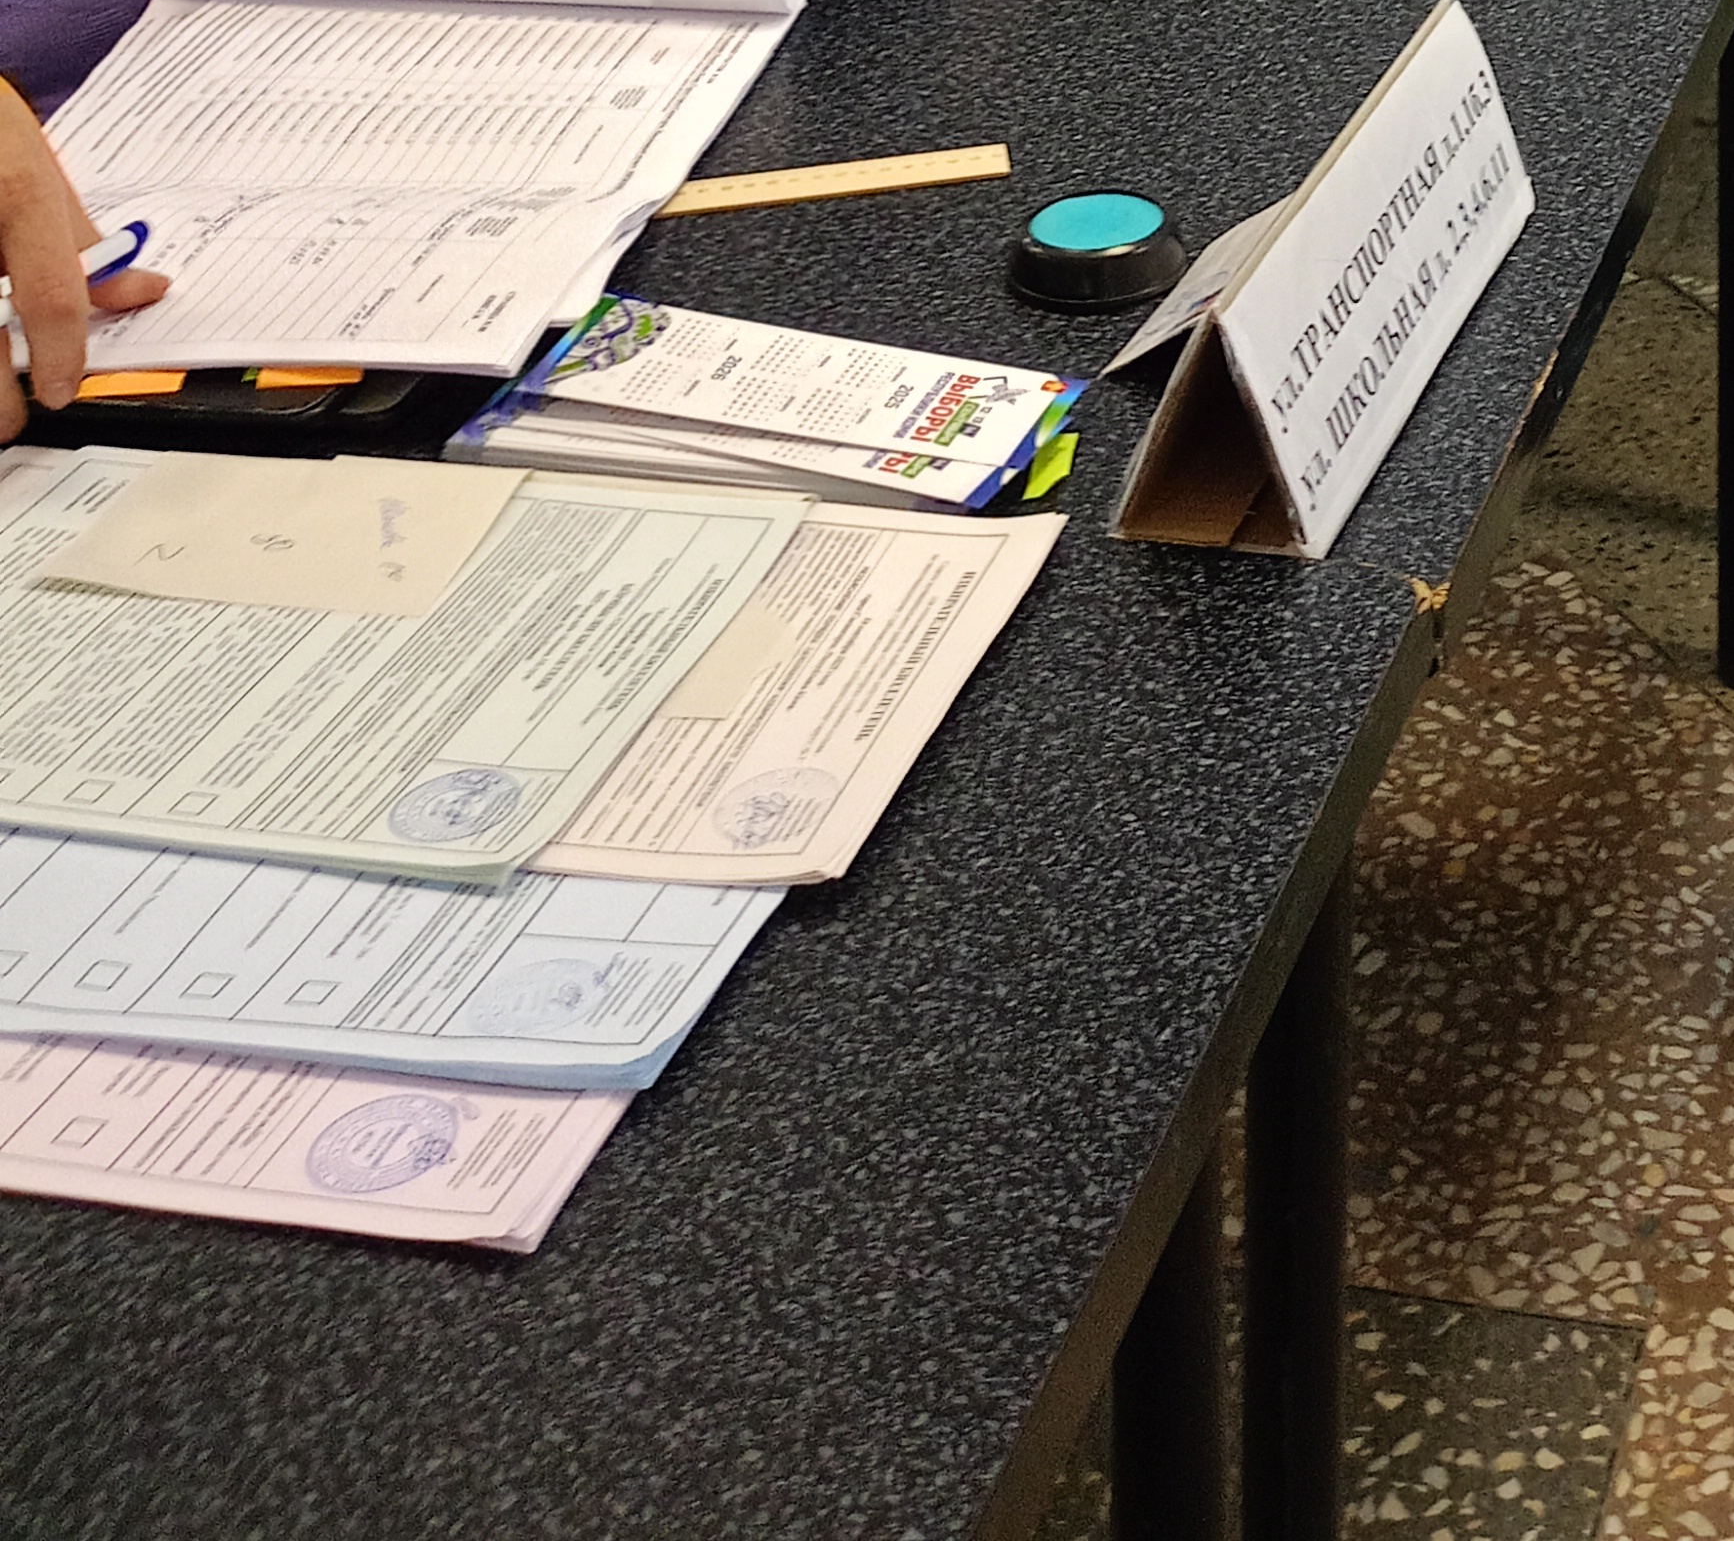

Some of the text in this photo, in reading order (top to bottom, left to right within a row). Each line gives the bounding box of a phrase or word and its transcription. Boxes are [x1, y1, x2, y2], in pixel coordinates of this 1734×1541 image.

[710, 355, 743, 381] 2026
[1299, 458, 1333, 512] ул.
[1325, 262, 1439, 450] ШКОЛЬНАЯ
[884, 384, 914, 409] 2025
[910, 374, 981, 443] ВЫБОРЫ
[912, 371, 956, 417] РЕСПУБЛИКИ
